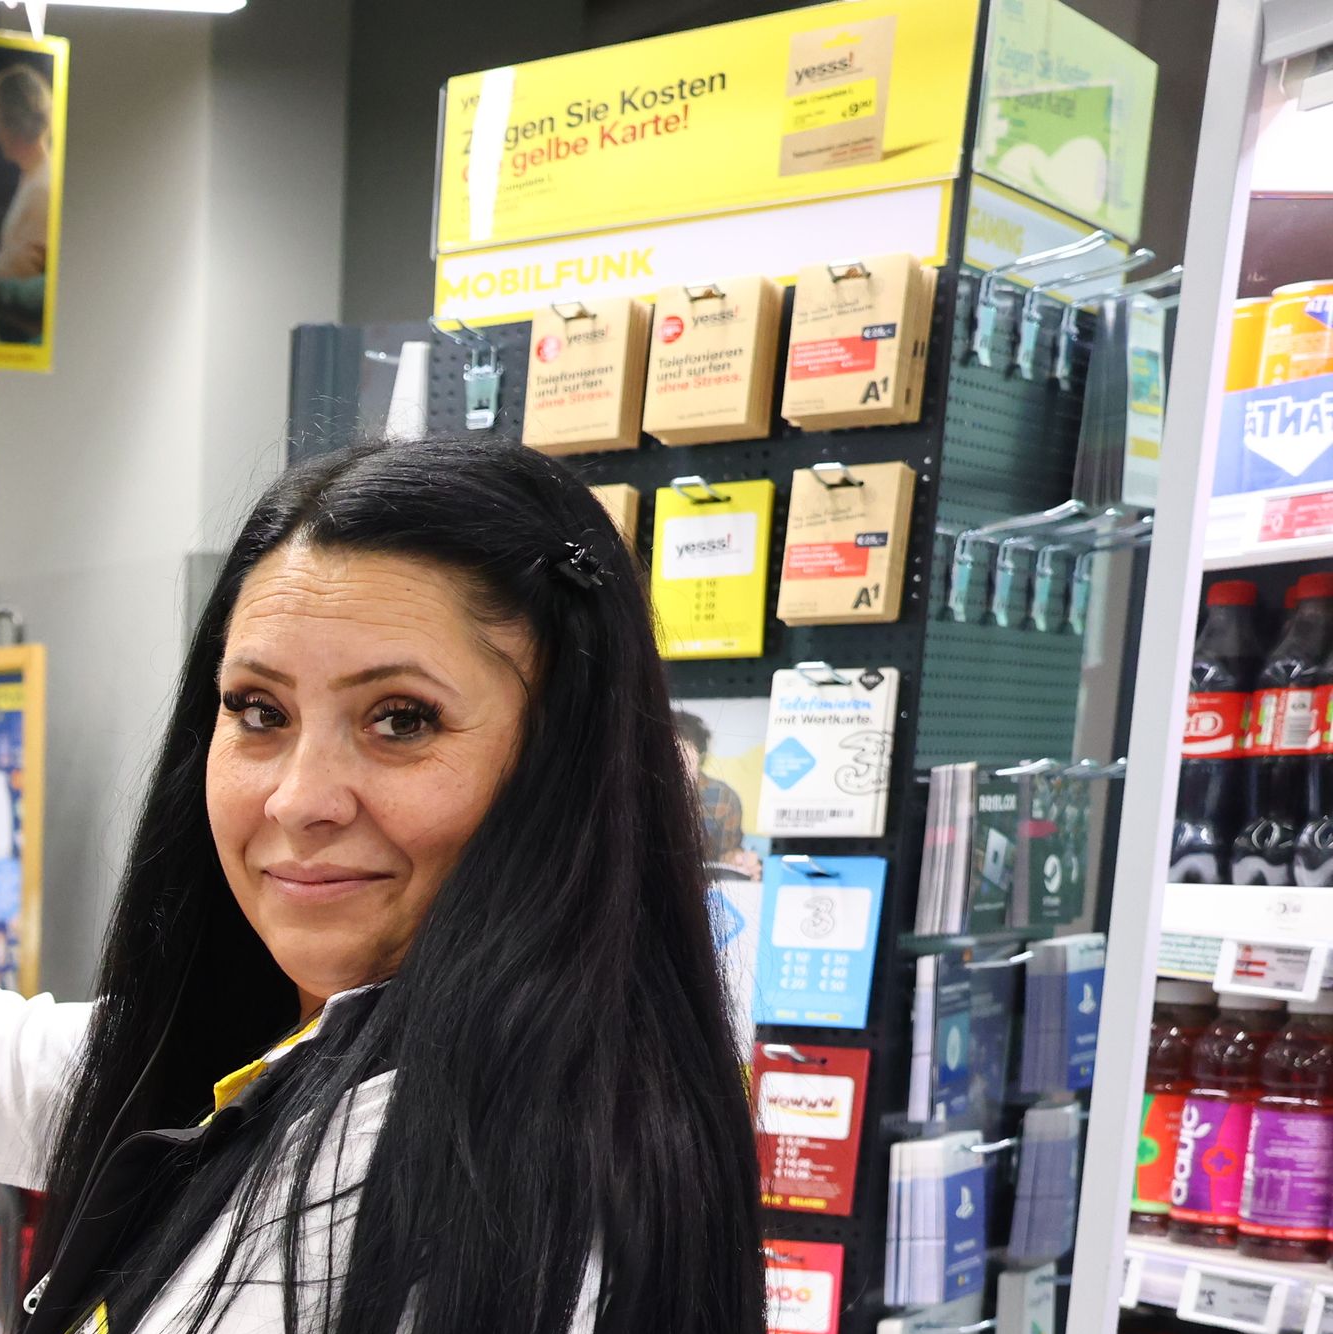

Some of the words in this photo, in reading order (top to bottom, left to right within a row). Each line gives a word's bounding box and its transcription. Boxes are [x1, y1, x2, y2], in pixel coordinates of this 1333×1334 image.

[795, 51, 854, 86] yesss!
[462, 114, 555, 155] Zgen
[566, 99, 610, 128] Sie
[620, 71, 727, 116] Kosten
[512, 136, 589, 178] gelbe
[599, 104, 691, 150] Karte!
[442, 247, 654, 303] MOBILFUNK
[675, 533, 731, 558] yesss!
